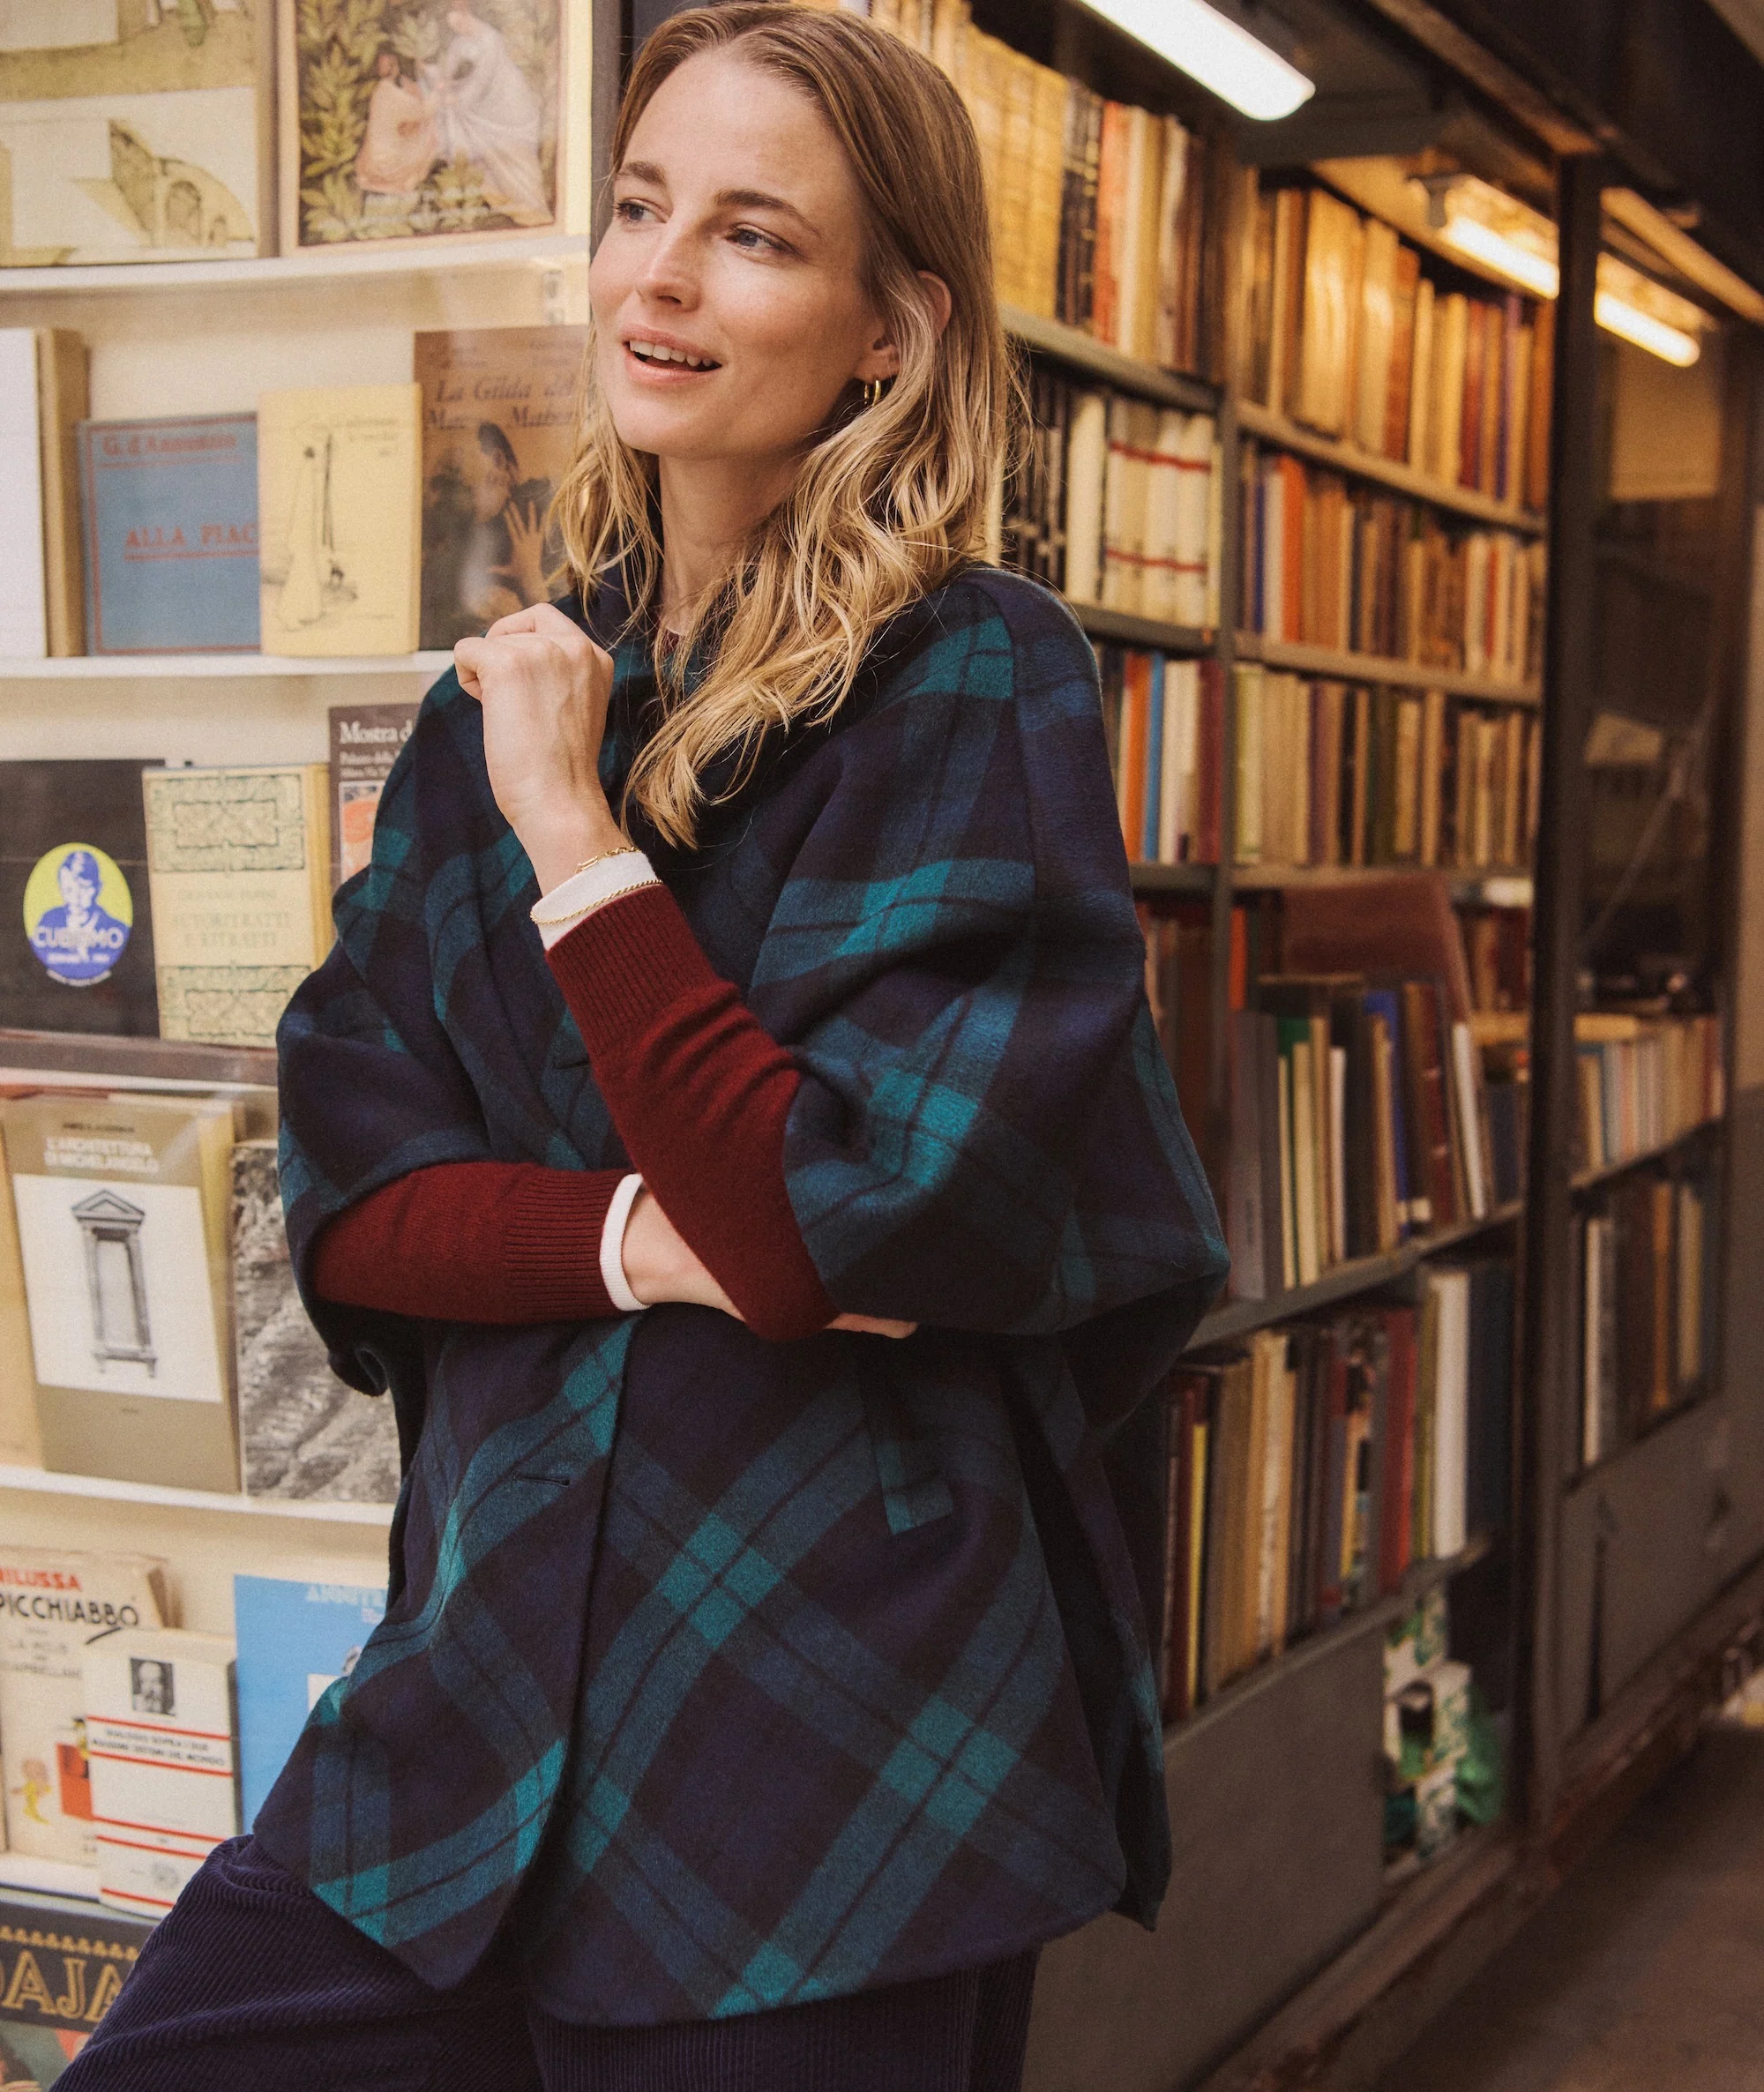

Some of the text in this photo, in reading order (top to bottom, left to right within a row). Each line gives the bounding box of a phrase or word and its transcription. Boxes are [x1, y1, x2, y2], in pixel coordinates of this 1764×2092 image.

[124, 525, 186, 549] ALLA
[339, 720, 399, 744] Mostra
[0, 1949, 126, 2023] AJA
